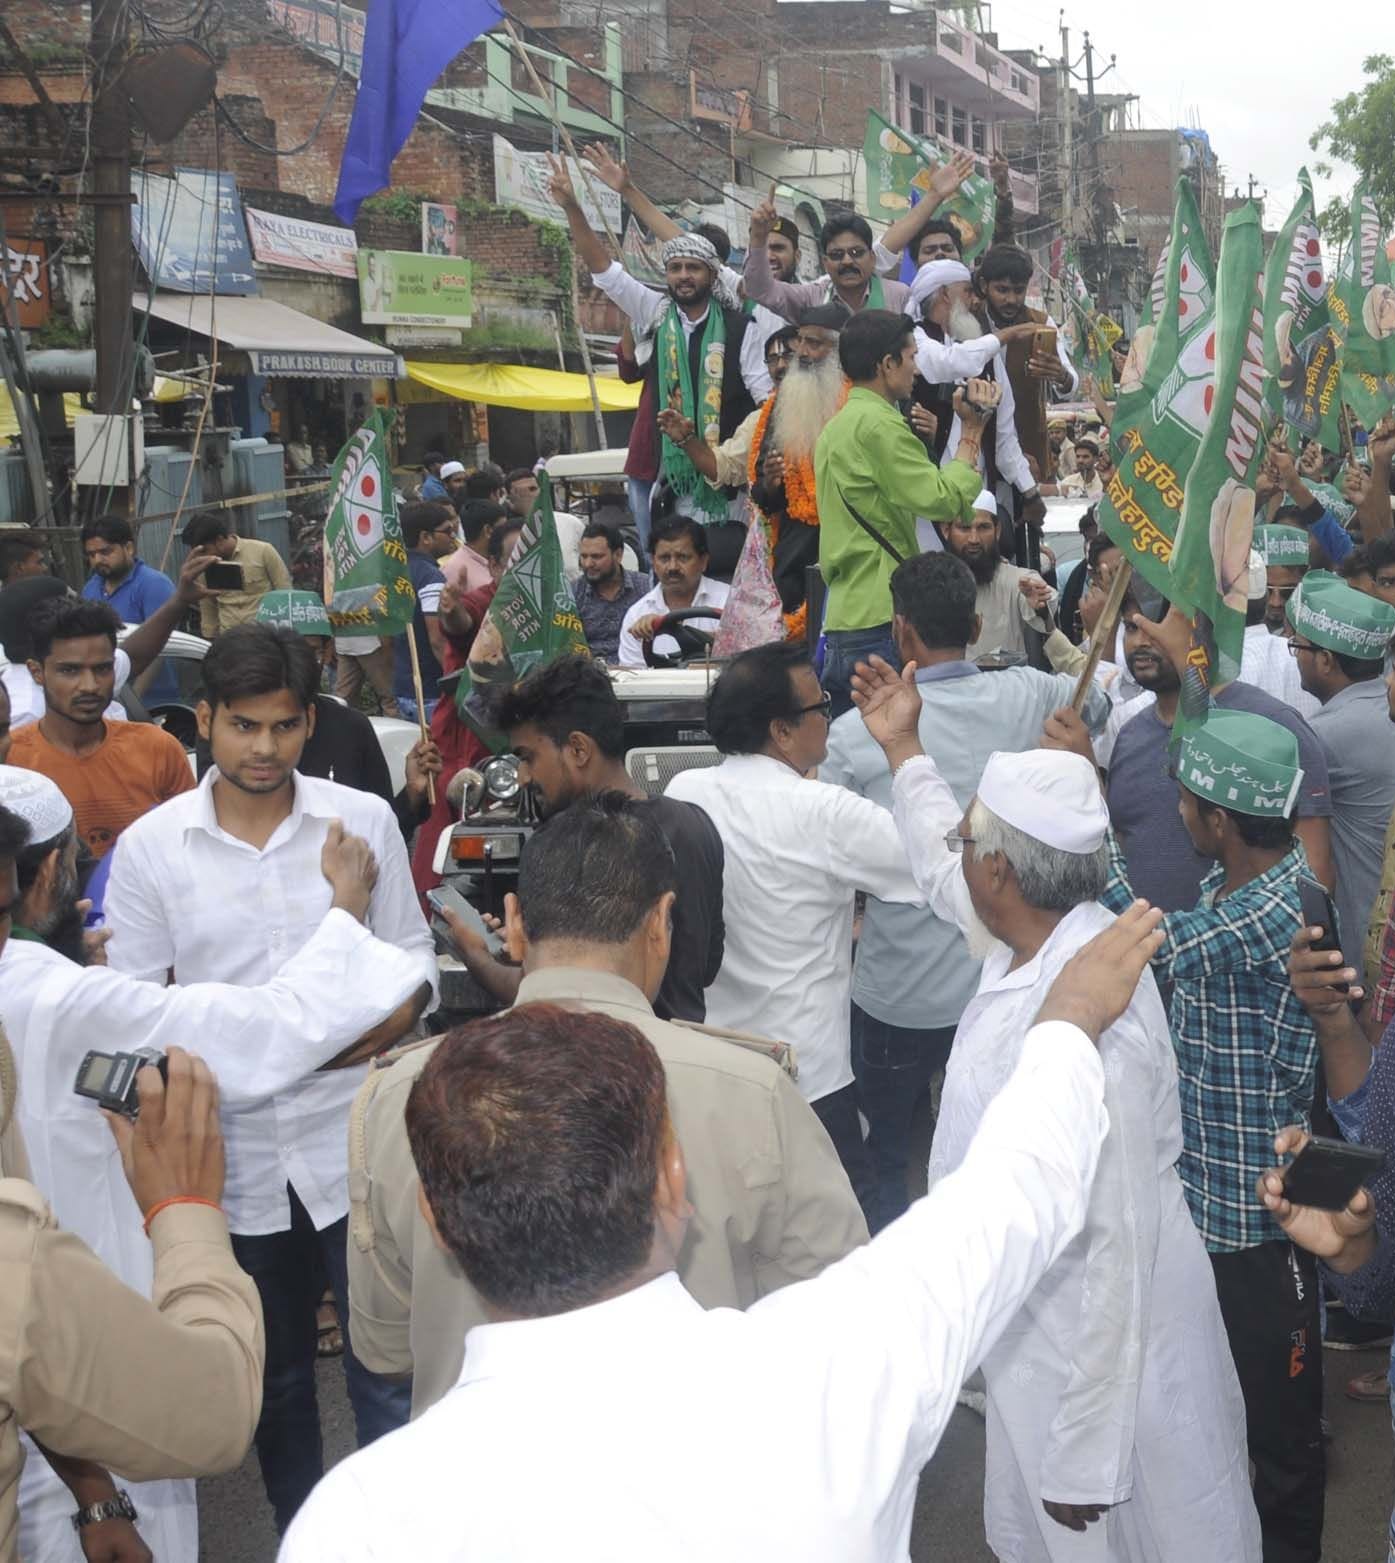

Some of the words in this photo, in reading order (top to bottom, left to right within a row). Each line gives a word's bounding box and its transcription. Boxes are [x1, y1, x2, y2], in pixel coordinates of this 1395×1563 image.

[263, 355, 321, 371] PRAKASH
[321, 357, 353, 373] BOOK
[354, 359, 395, 374] CENTER
